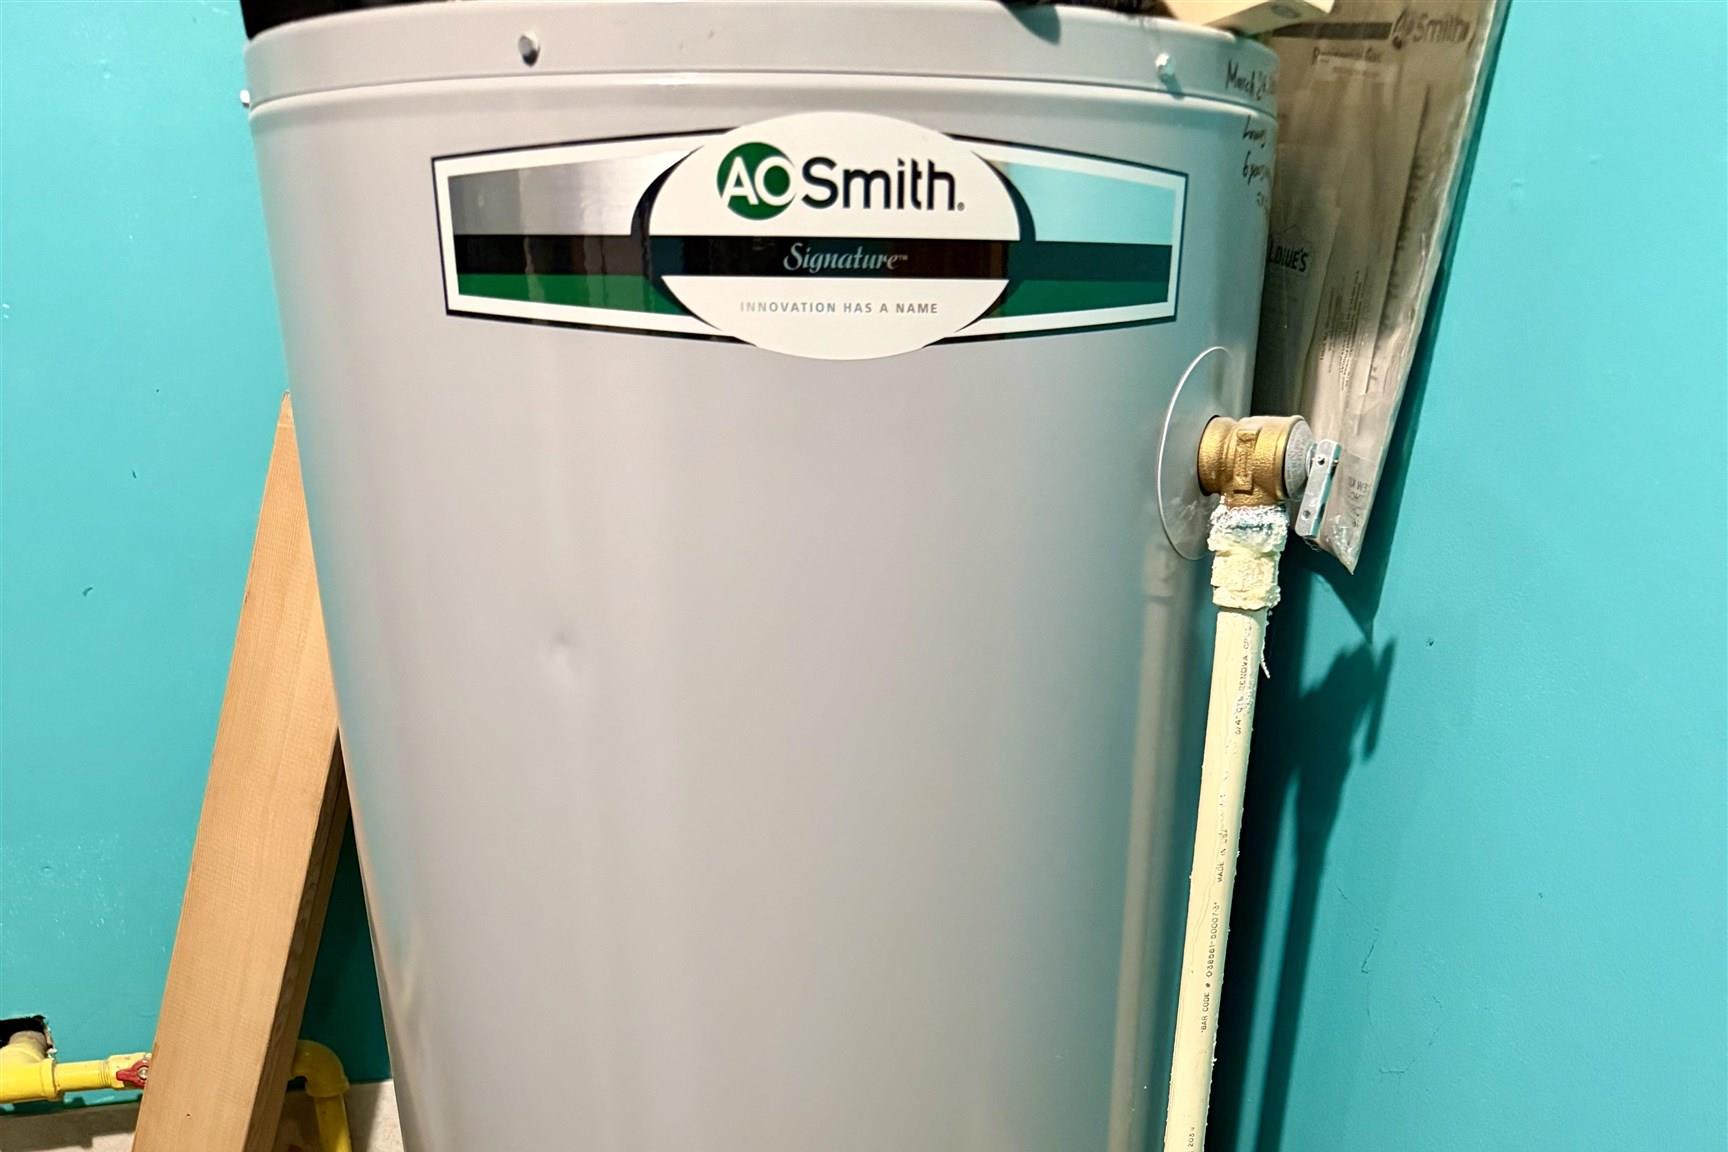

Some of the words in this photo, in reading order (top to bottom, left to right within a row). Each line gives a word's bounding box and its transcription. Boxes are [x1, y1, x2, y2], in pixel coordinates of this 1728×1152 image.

[739, 300, 837, 315] INNOVATION
[843, 300, 874, 315] HAS
[880, 300, 891, 315] A
[896, 300, 939, 315] NAME
